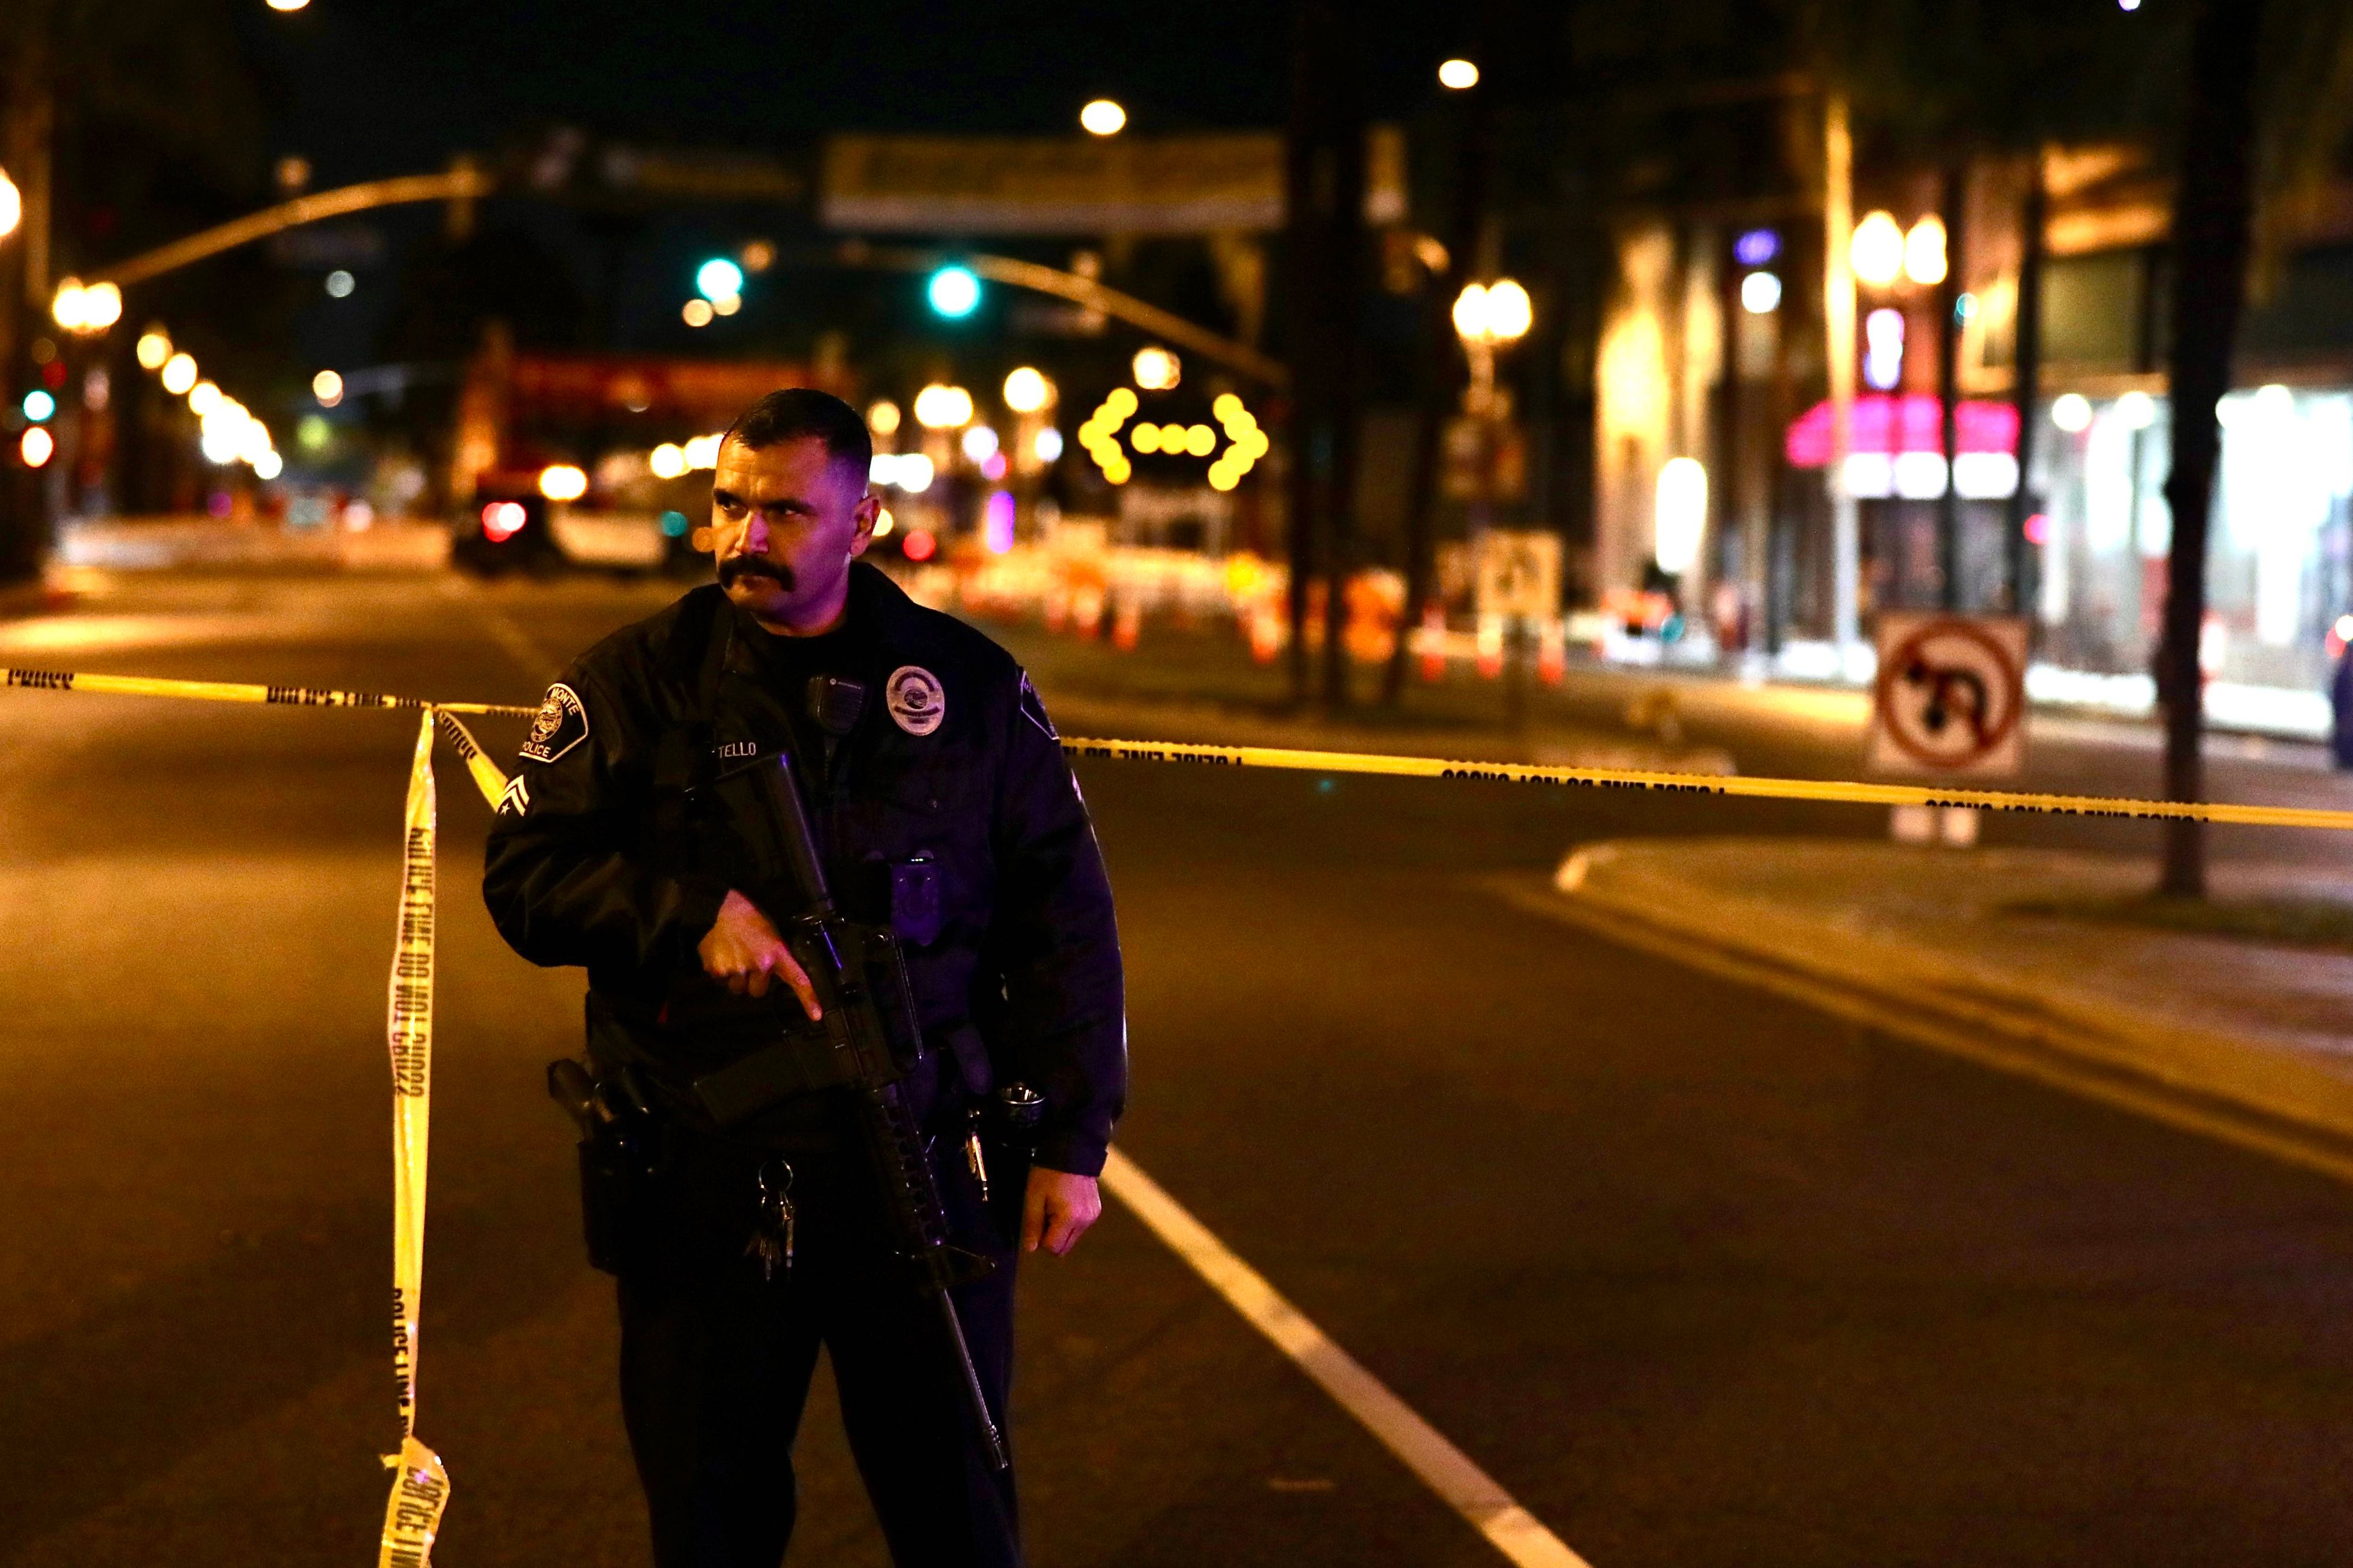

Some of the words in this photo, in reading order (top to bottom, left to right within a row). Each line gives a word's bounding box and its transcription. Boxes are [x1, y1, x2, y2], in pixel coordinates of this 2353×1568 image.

[551, 688, 579, 716] MONTE
[522, 741, 552, 758] POLICE
[718, 741, 756, 759] TELLO
